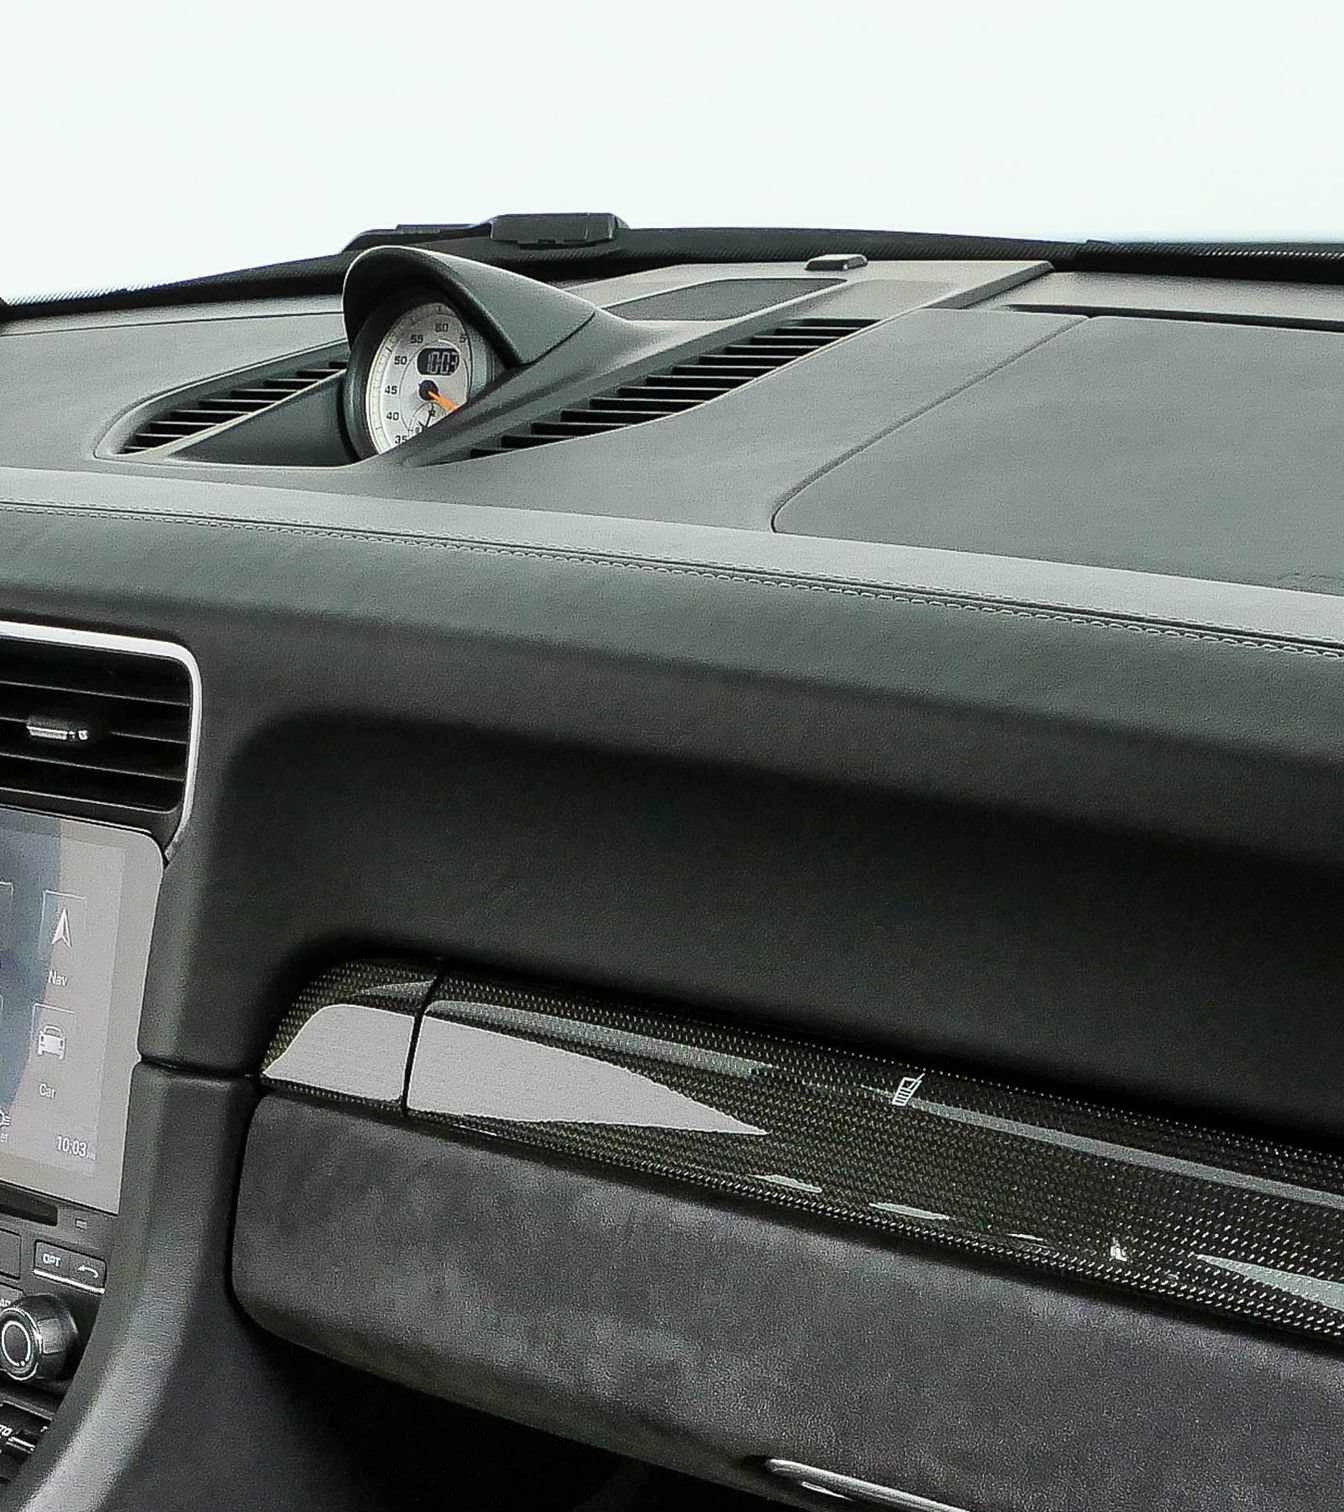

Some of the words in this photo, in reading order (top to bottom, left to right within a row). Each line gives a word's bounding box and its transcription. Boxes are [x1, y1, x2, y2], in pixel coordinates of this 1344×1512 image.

[435, 323, 449, 333] 60
[410, 334, 423, 344] 55
[394, 356, 407, 366] 50
[384, 385, 398, 395] 45
[386, 411, 400, 421] 40
[394, 434, 408, 445] 35
[48, 970, 69, 987] Nav
[39, 1083, 56, 1099] Car
[56, 1135, 87, 1158] 10:03
[42, 1253, 61, 1267] OPT
